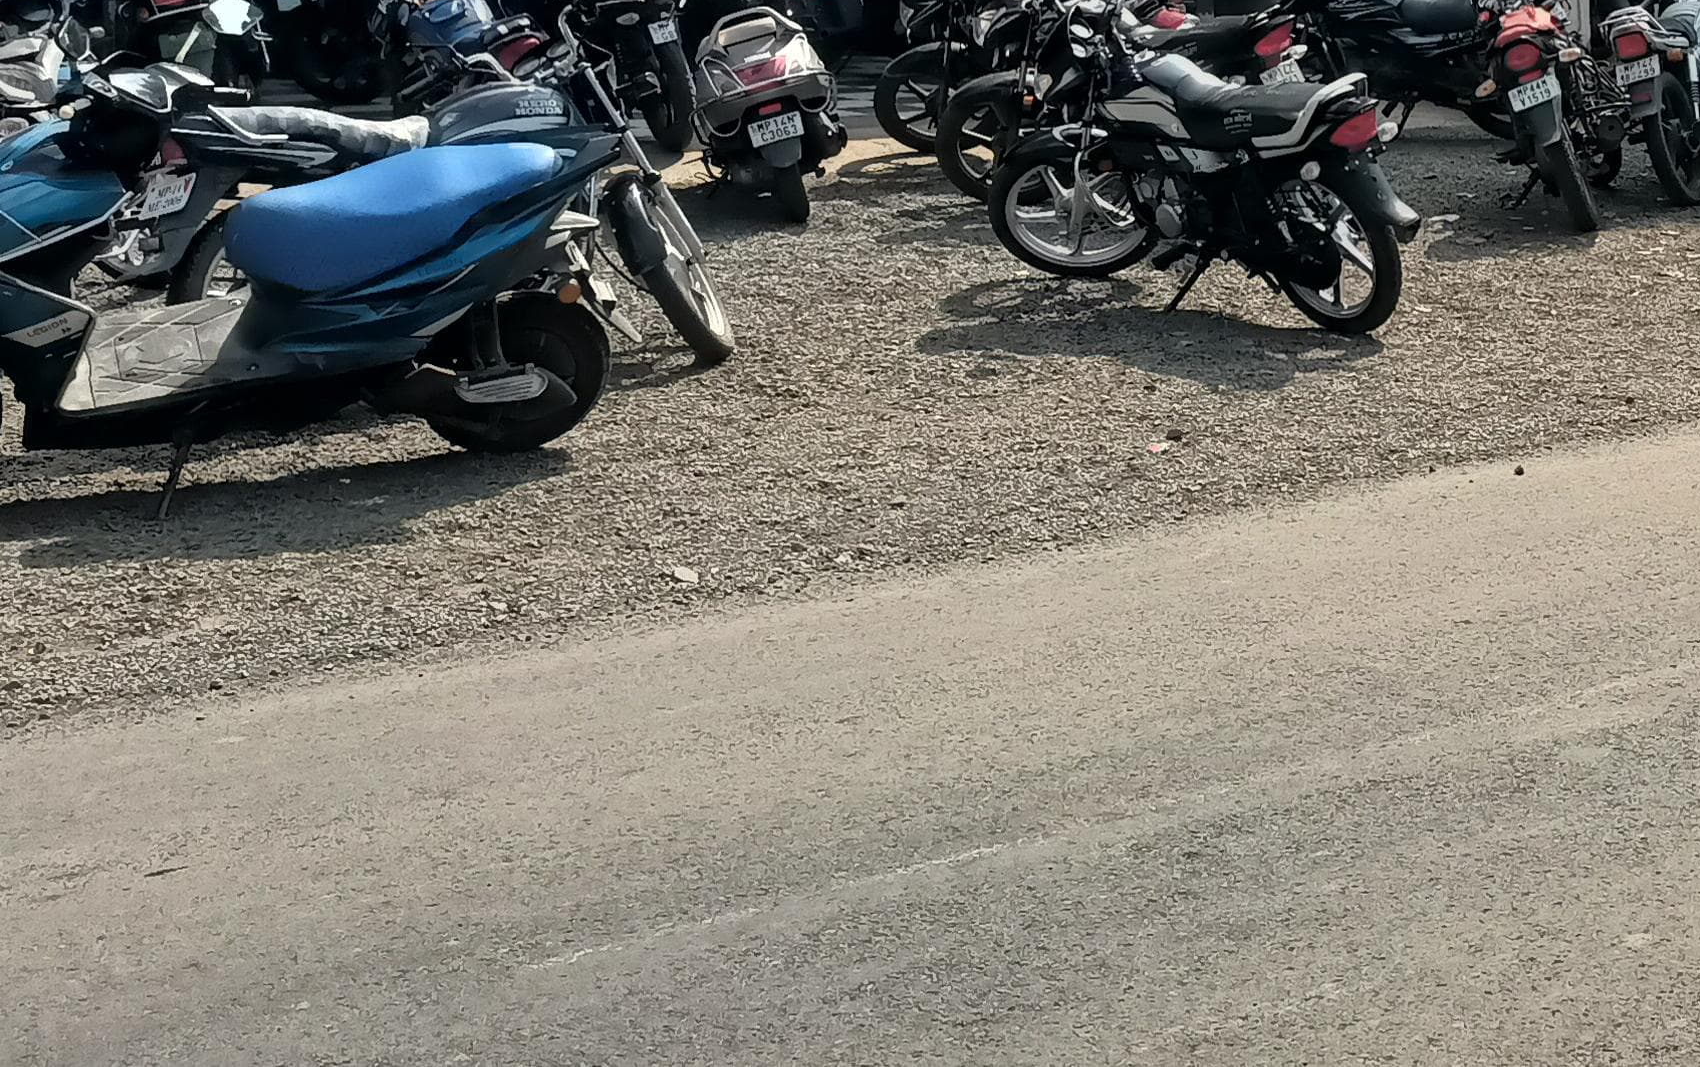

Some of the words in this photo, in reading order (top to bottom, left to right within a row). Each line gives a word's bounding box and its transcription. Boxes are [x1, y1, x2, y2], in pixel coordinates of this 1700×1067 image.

[519, 99, 557, 108] HERO
[516, 107, 563, 116] HONDA
[760, 124, 799, 142] C3063
